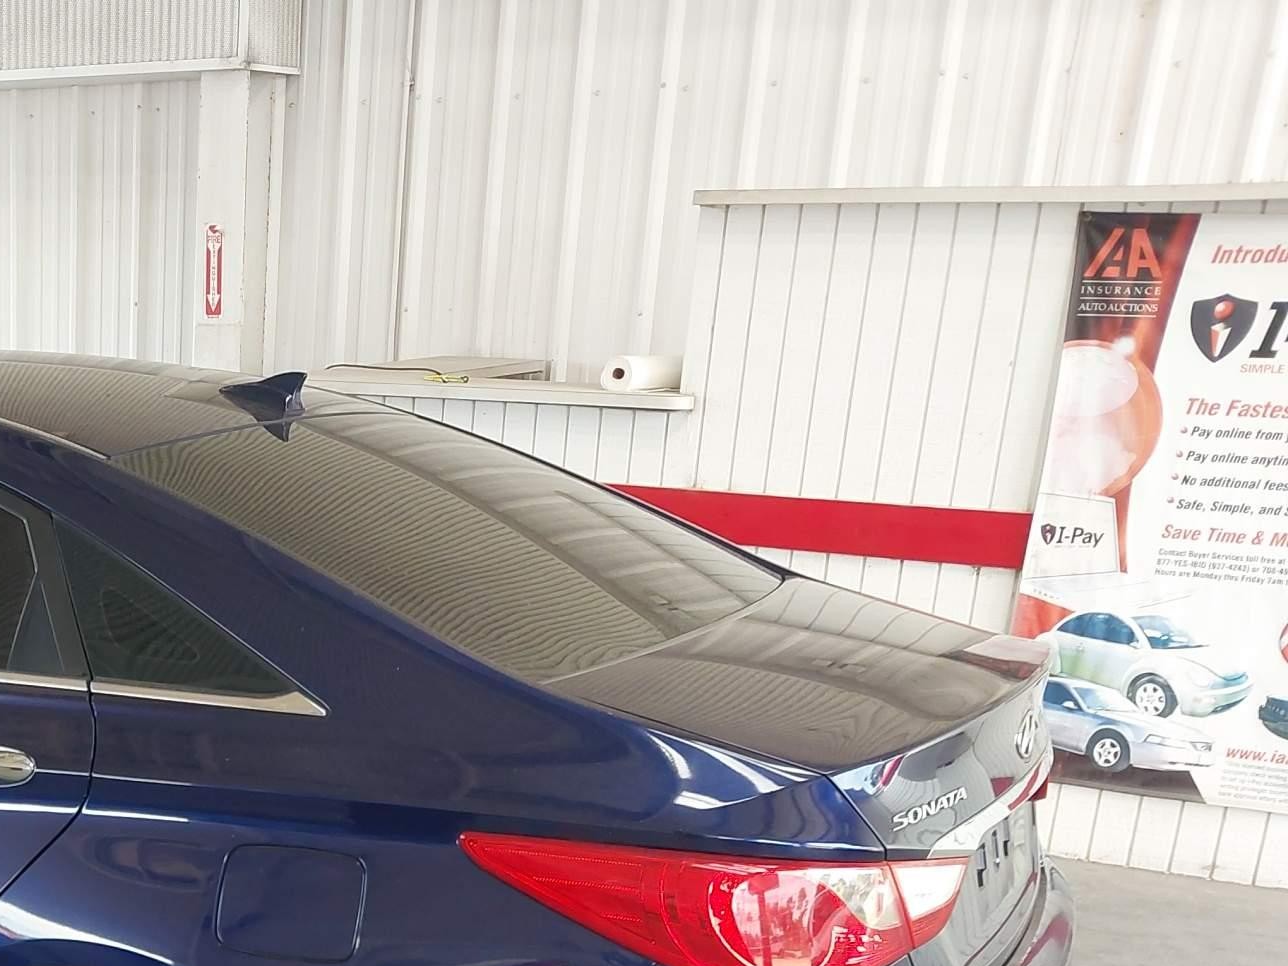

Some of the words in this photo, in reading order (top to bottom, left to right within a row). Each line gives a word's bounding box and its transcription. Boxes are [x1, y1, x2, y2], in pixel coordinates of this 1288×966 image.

[1080, 285, 1161, 296] INSURANCE
[1078, 302, 1107, 311] AUTO
[1107, 303, 1159, 312] AUCTIONS
[1240, 363, 1285, 374] SIMPLE
[1186, 398, 1221, 416] The
[1191, 426, 1212, 439] Pay
[1215, 427, 1253, 439] online
[1255, 429, 1283, 440] from
[1186, 450, 1209, 464] Pay
[1211, 452, 1248, 464] online
[1181, 475, 1197, 485] No
[1200, 476, 1261, 489] additional
[1264, 480, 1288, 491] fees
[1176, 499, 1206, 512] Safe,
[1210, 501, 1254, 515] Simple,
[1258, 505, 1282, 516] and
[1056, 526, 1105, 548] I-Pay
[1161, 524, 1201, 540] Save
[1207, 527, 1247, 544] Time
[1251, 530, 1264, 545] &
[892, 786, 967, 832] SONATA
